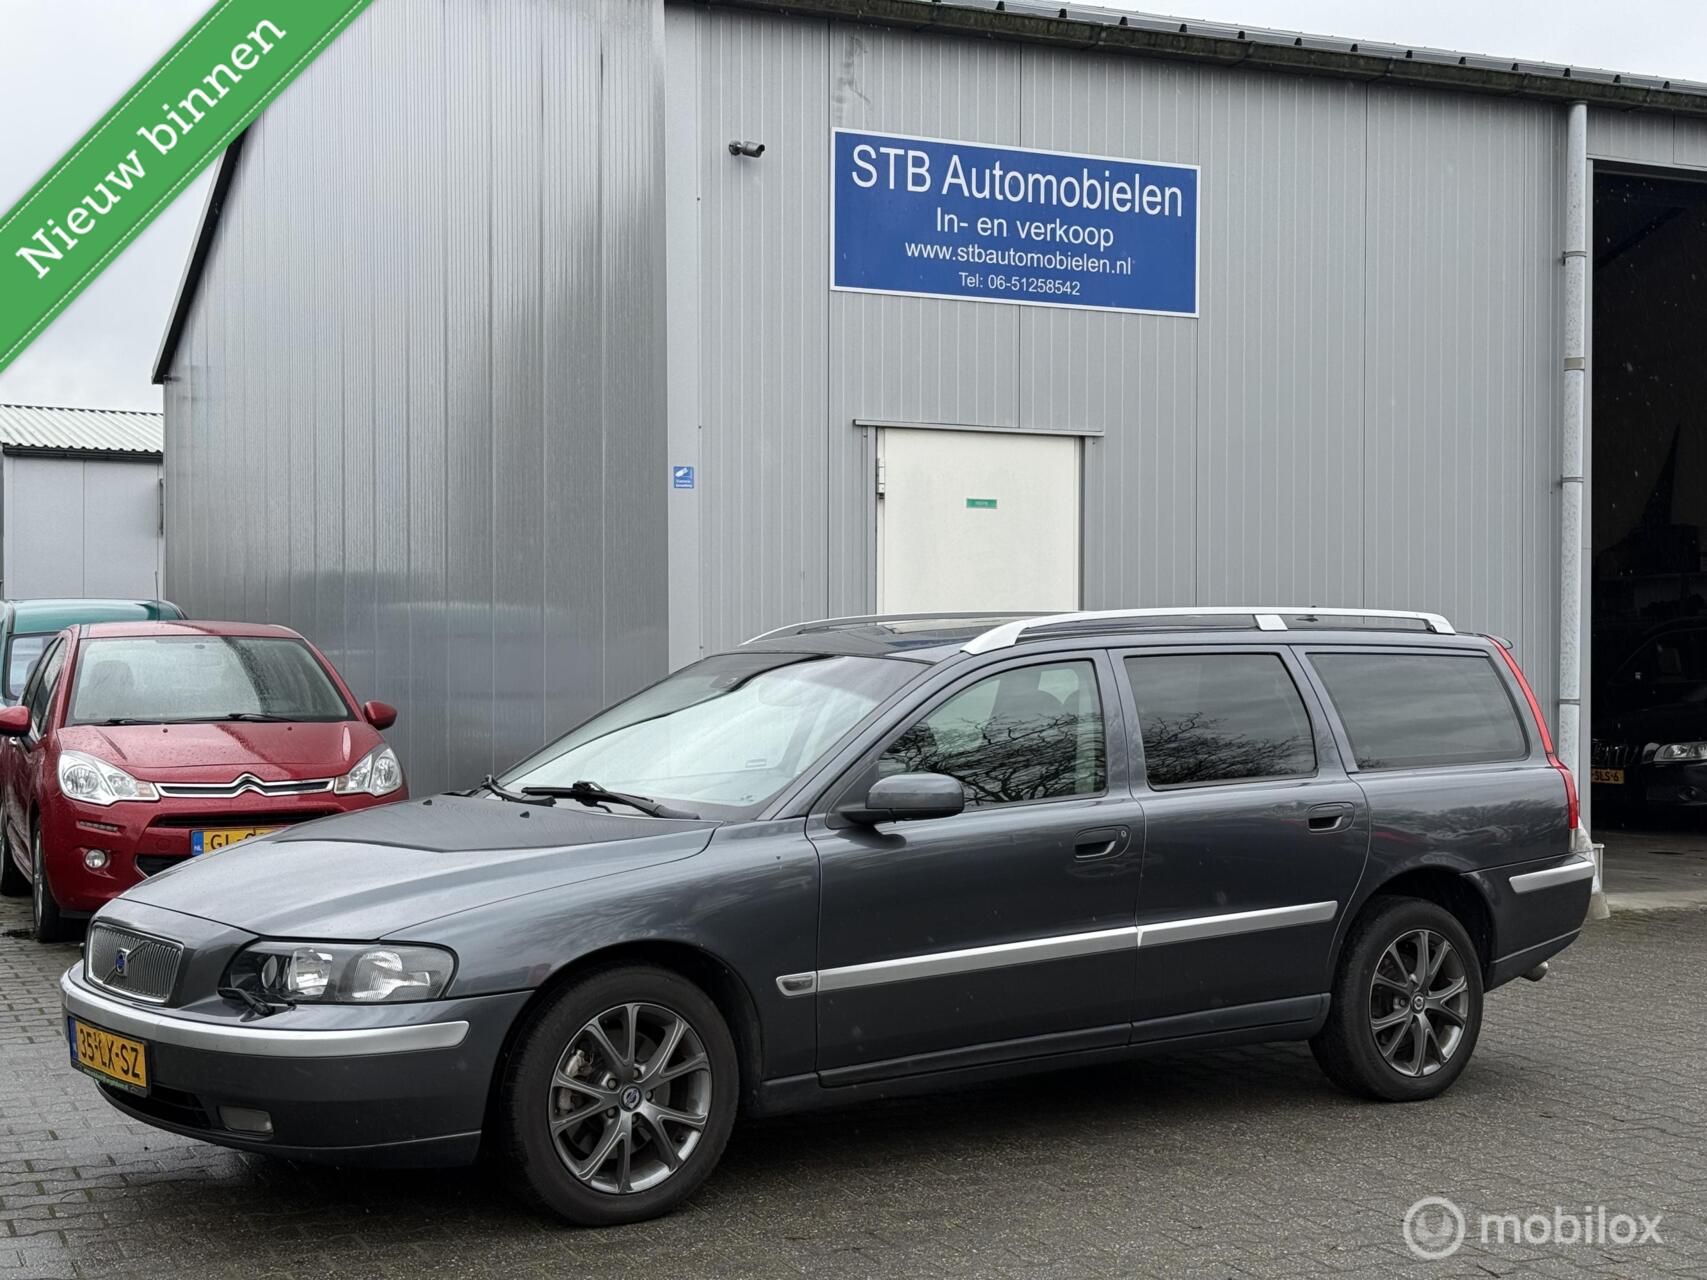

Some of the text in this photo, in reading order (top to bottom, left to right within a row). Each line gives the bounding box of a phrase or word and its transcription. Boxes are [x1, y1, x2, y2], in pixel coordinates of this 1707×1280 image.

[851, 144, 1183, 217] STB Automobielen
[936, 207, 1114, 251] In- en verkoop
[905, 242, 1132, 275] www.stbautomobielen.nl
[958, 272, 1080, 296] Tel: 06-51258542
[80, 1028, 140, 1079] 35-LX-SZ
